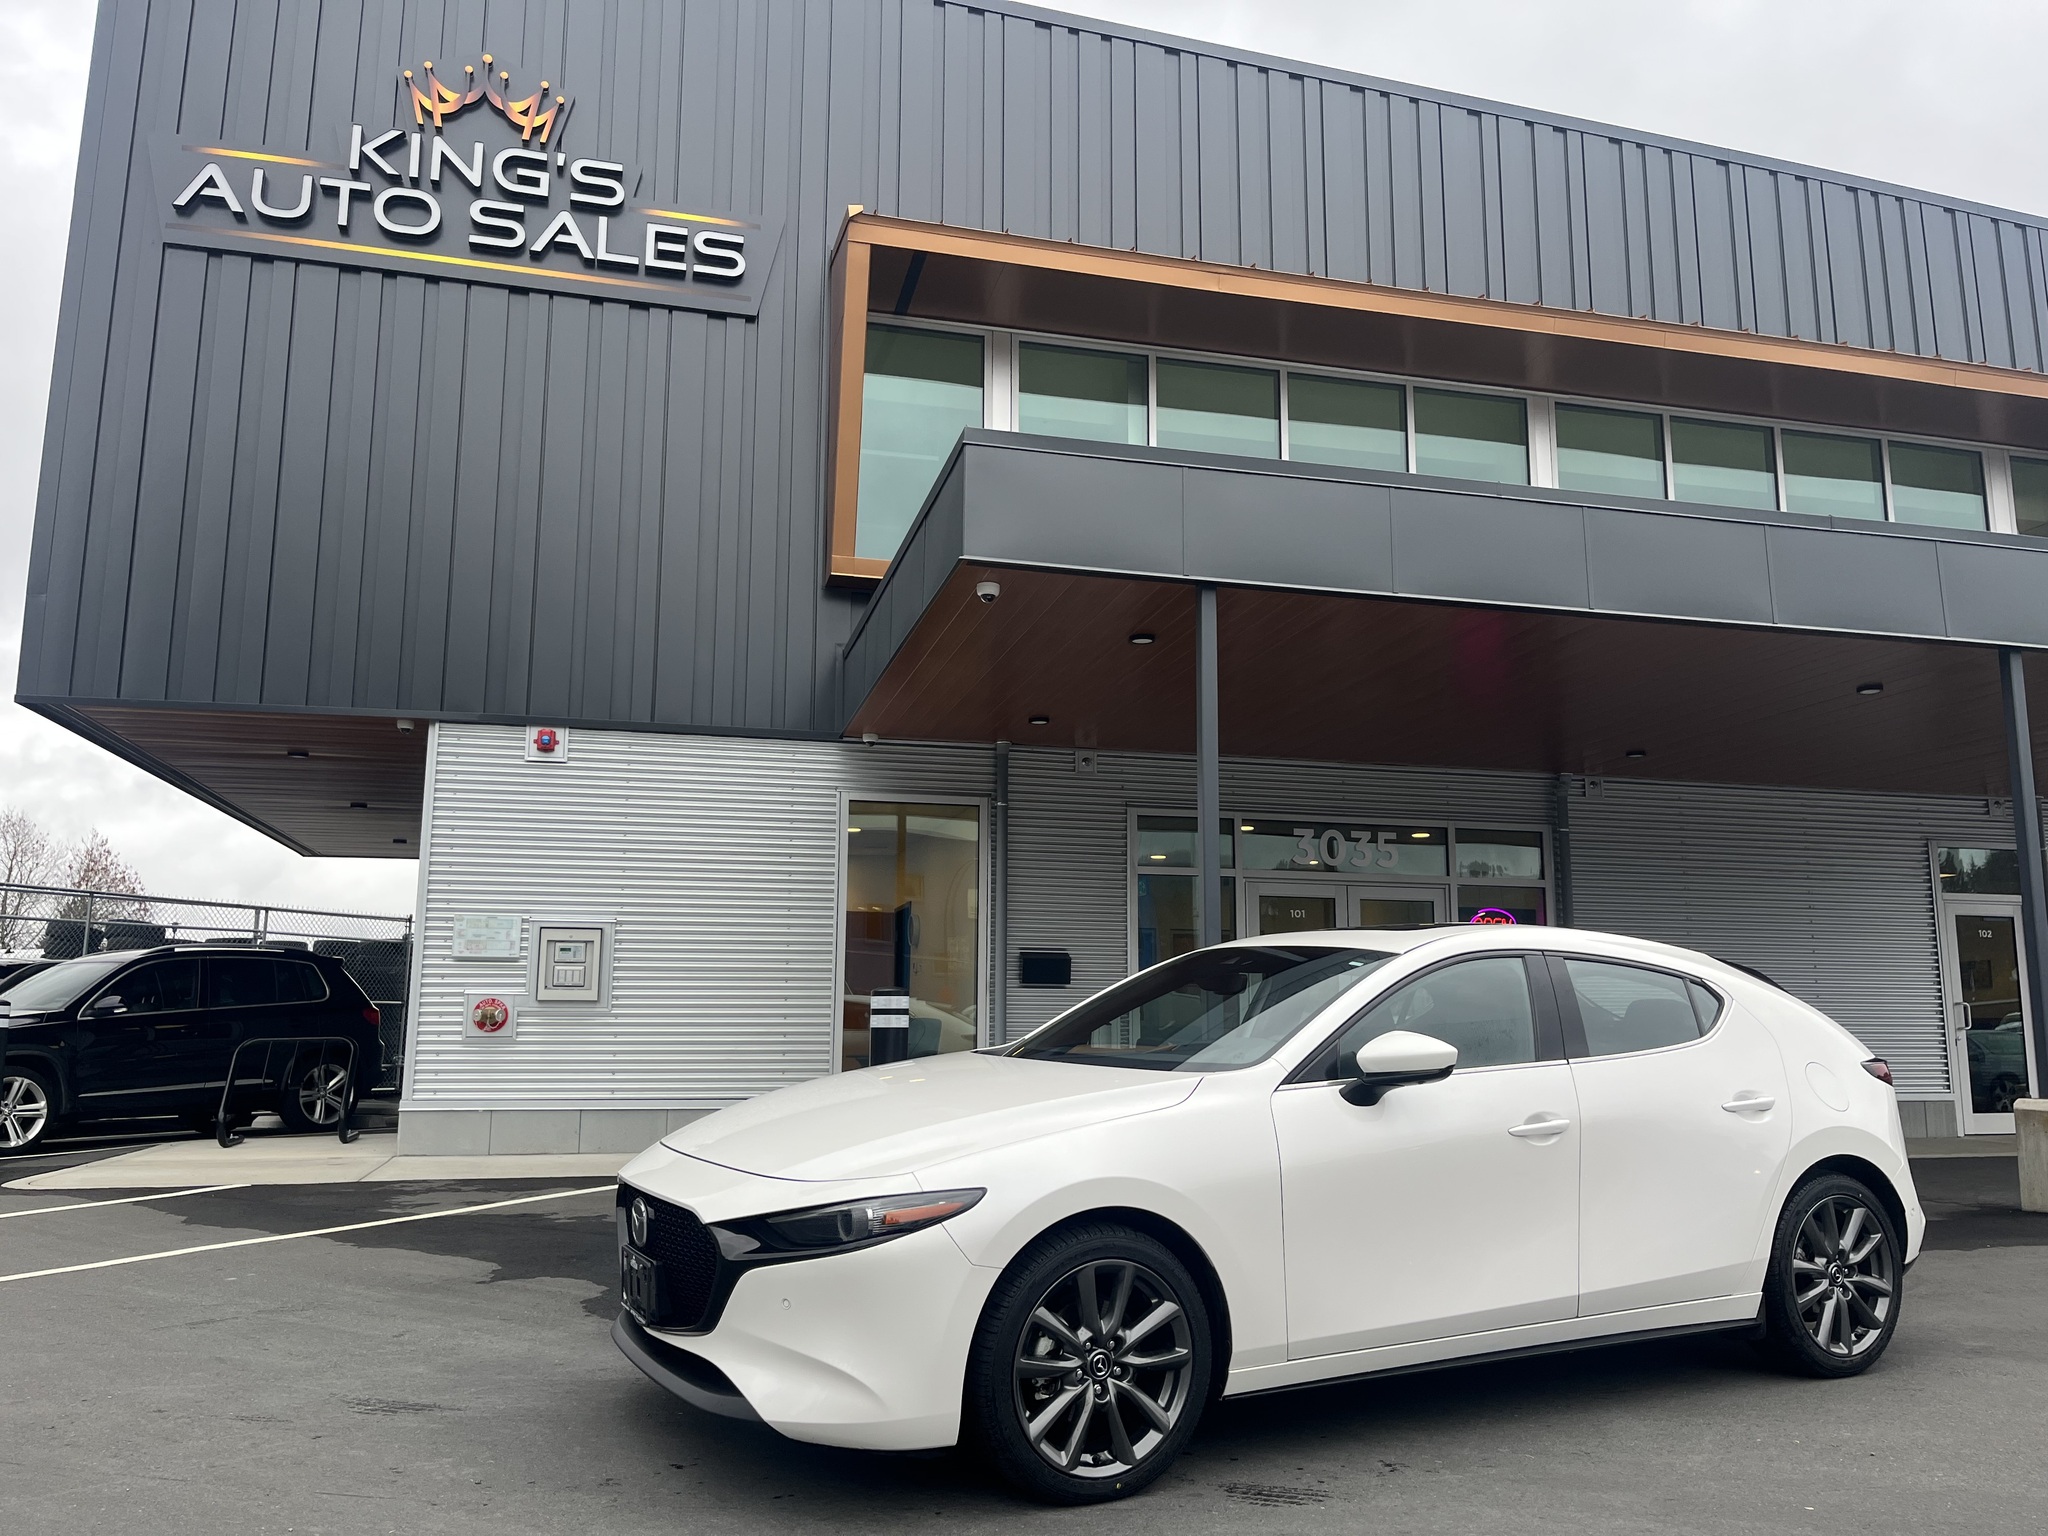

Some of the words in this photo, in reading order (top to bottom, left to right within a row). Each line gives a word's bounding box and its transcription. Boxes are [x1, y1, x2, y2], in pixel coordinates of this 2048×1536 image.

[349, 124, 626, 208] KING'S
[173, 162, 442, 236] AUTO
[468, 200, 747, 278] SALES
[1292, 827, 1399, 868] 3035
[1289, 909, 1306, 918] 101
[1978, 929, 1993, 938] 102
